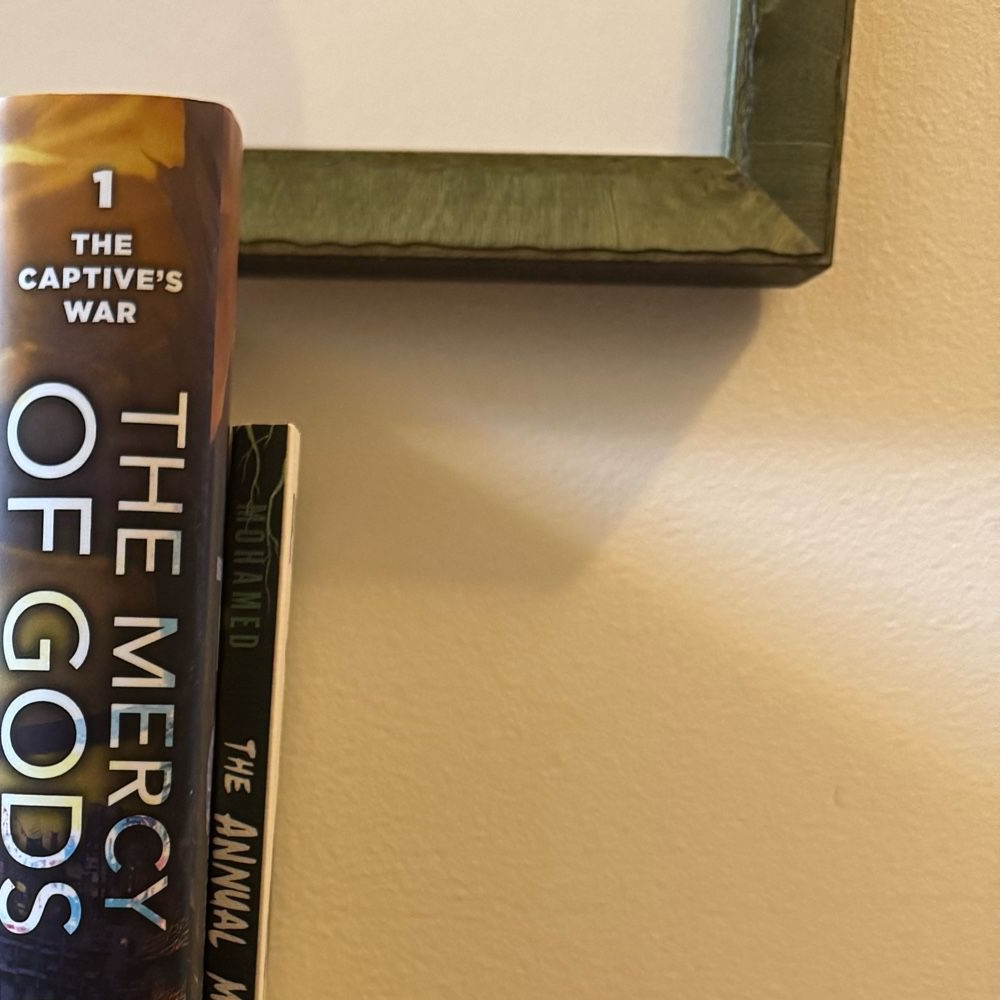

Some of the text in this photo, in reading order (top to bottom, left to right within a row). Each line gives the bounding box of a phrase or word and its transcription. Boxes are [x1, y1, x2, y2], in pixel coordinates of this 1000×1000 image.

[91, 169, 115, 210] 1
[70, 232, 133, 257] THE
[17, 266, 184, 294] CAPTIVE'S
[62, 299, 137, 325] WAR
[6, 382, 97, 555] OF
[229, 503, 268, 650] MOHAMED
[104, 391, 188, 932] THE MERCY
[223, 739, 256, 795] THE
[203, 812, 259, 949] ANNUAL
